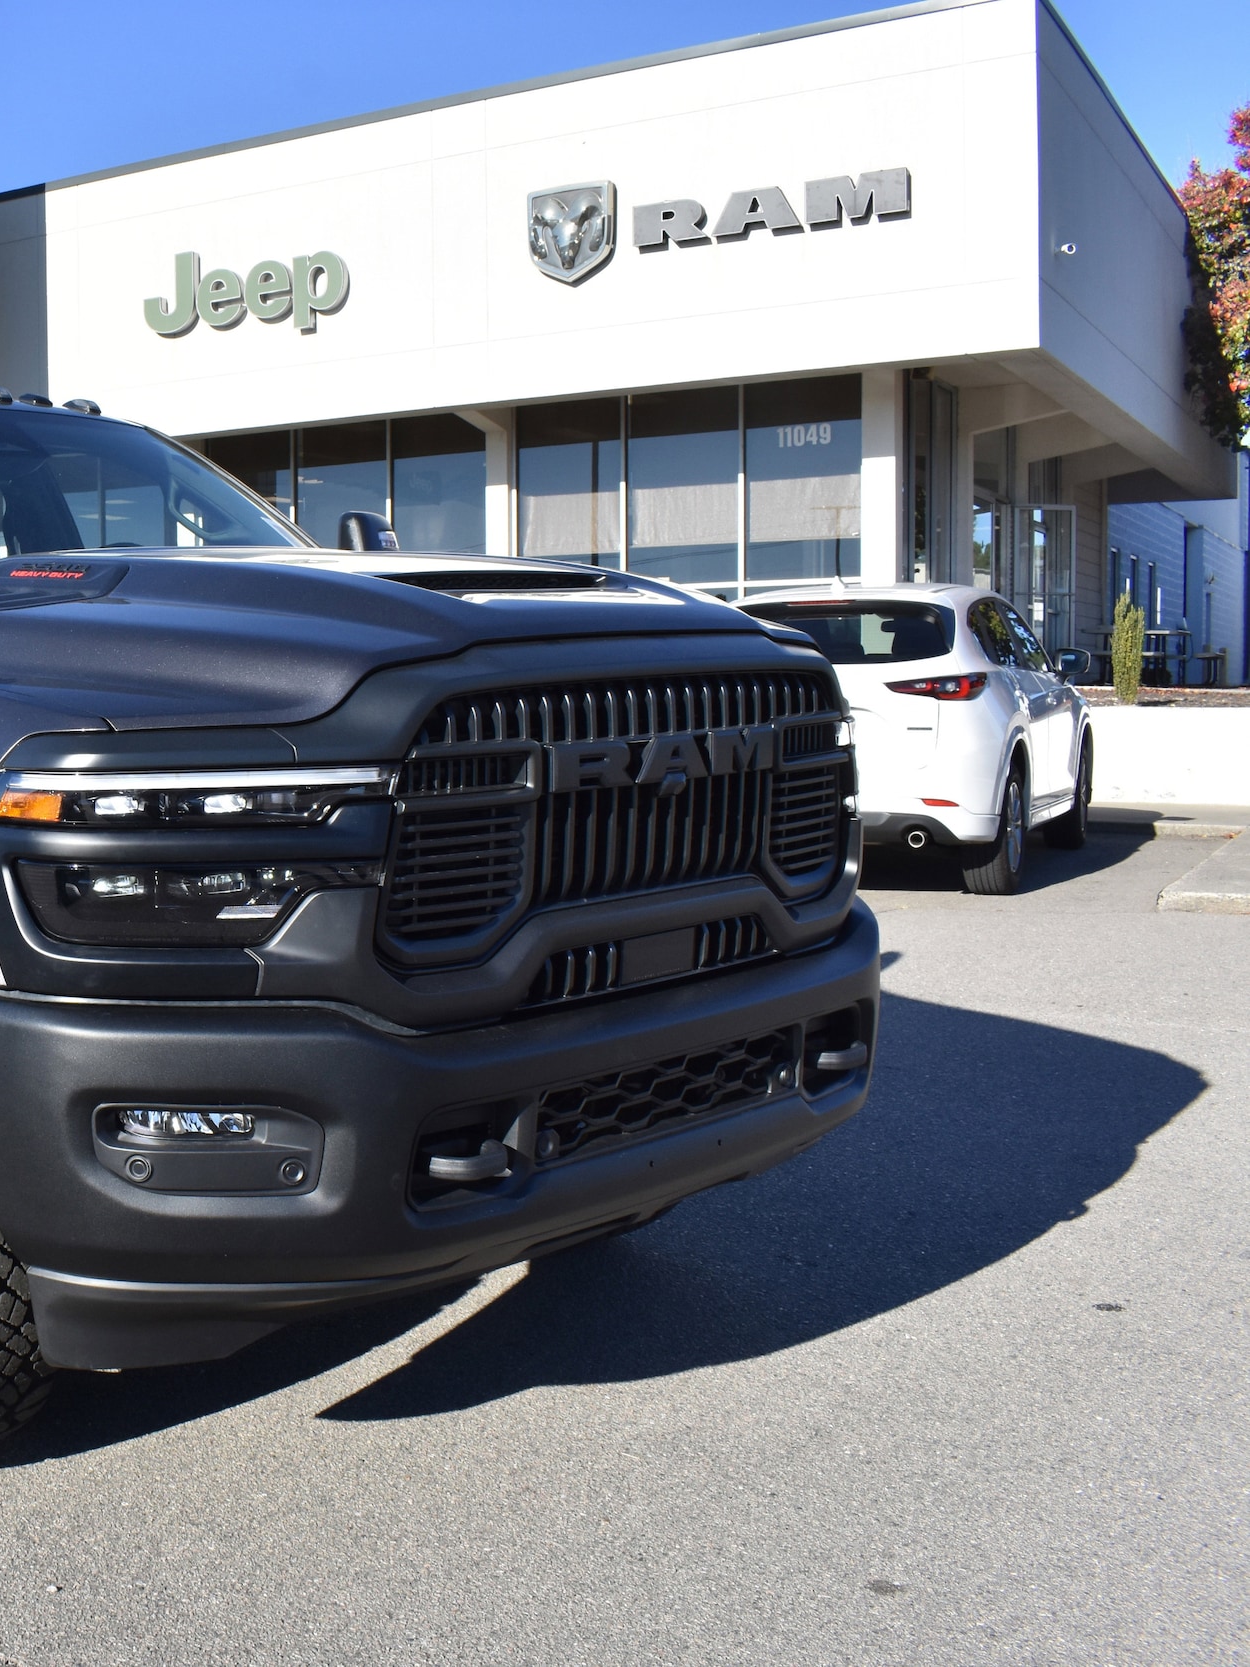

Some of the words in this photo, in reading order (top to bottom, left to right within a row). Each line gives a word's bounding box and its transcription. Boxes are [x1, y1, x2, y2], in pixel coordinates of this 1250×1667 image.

[632, 167, 912, 253] RAM
[143, 250, 350, 338] Jeep
[777, 423, 832, 448] 11049
[10, 570, 49, 579] HEAVY
[48, 571, 84, 579] DUTY
[550, 725, 774, 793] RAM
